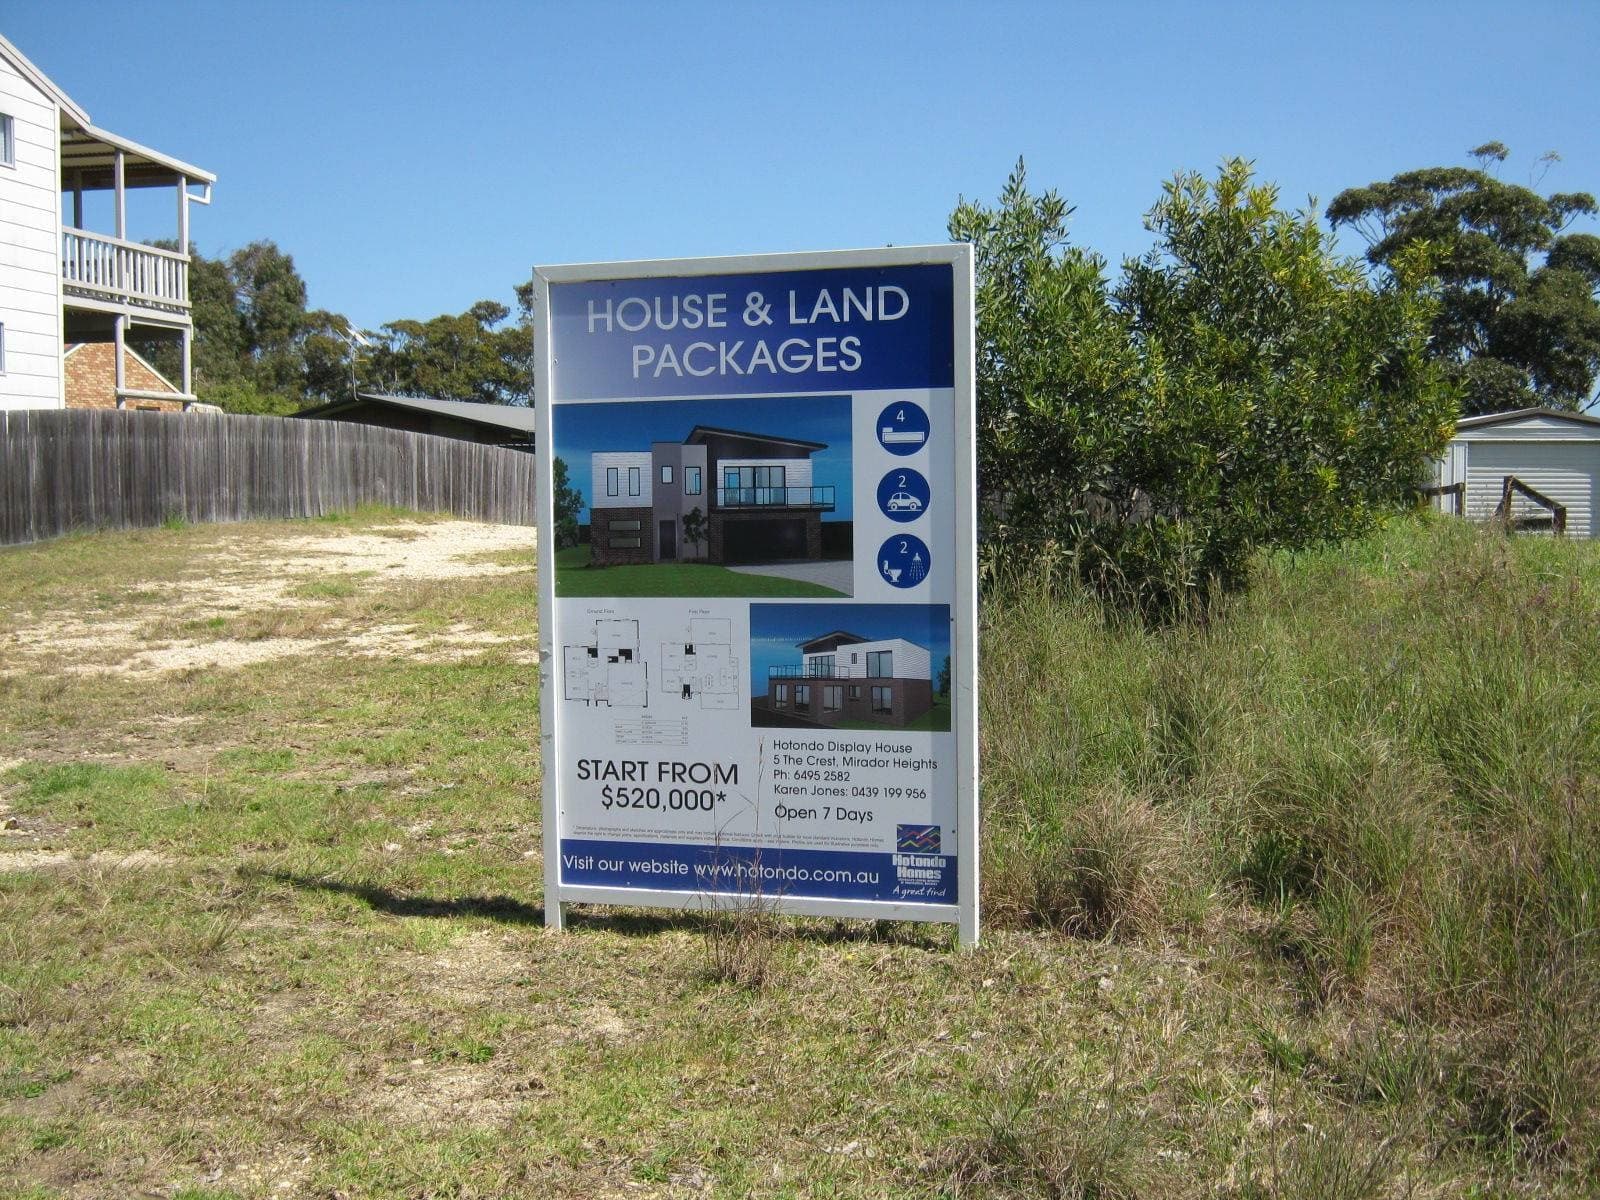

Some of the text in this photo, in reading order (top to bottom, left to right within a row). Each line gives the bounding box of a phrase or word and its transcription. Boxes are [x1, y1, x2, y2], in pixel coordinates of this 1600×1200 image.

[587, 285, 910, 333] HOUSE & LAND
[632, 336, 862, 378] PACKAGES
[896, 410, 905, 422] 4
[898, 475, 906, 487] 2
[900, 542, 908, 553] 2
[773, 740, 912, 754] Hotondo Display House
[773, 755, 938, 771] 5 The Crest, Mirador Heights
[577, 759, 738, 785] START FROM
[773, 769, 850, 782] Ph: 6495 2582
[774, 785, 927, 799] Karen Jones: 0439 199 956
[774, 804, 873, 824] Open 7 Days
[892, 854, 946, 867] Hotondo
[562, 855, 594, 870] Visit
[598, 859, 624, 872] our
[628, 858, 689, 875] website
[693, 864, 879, 884] www.hotondo.com.au
[897, 866, 941, 879] Homes
[892, 885, 946, 899] A great find
